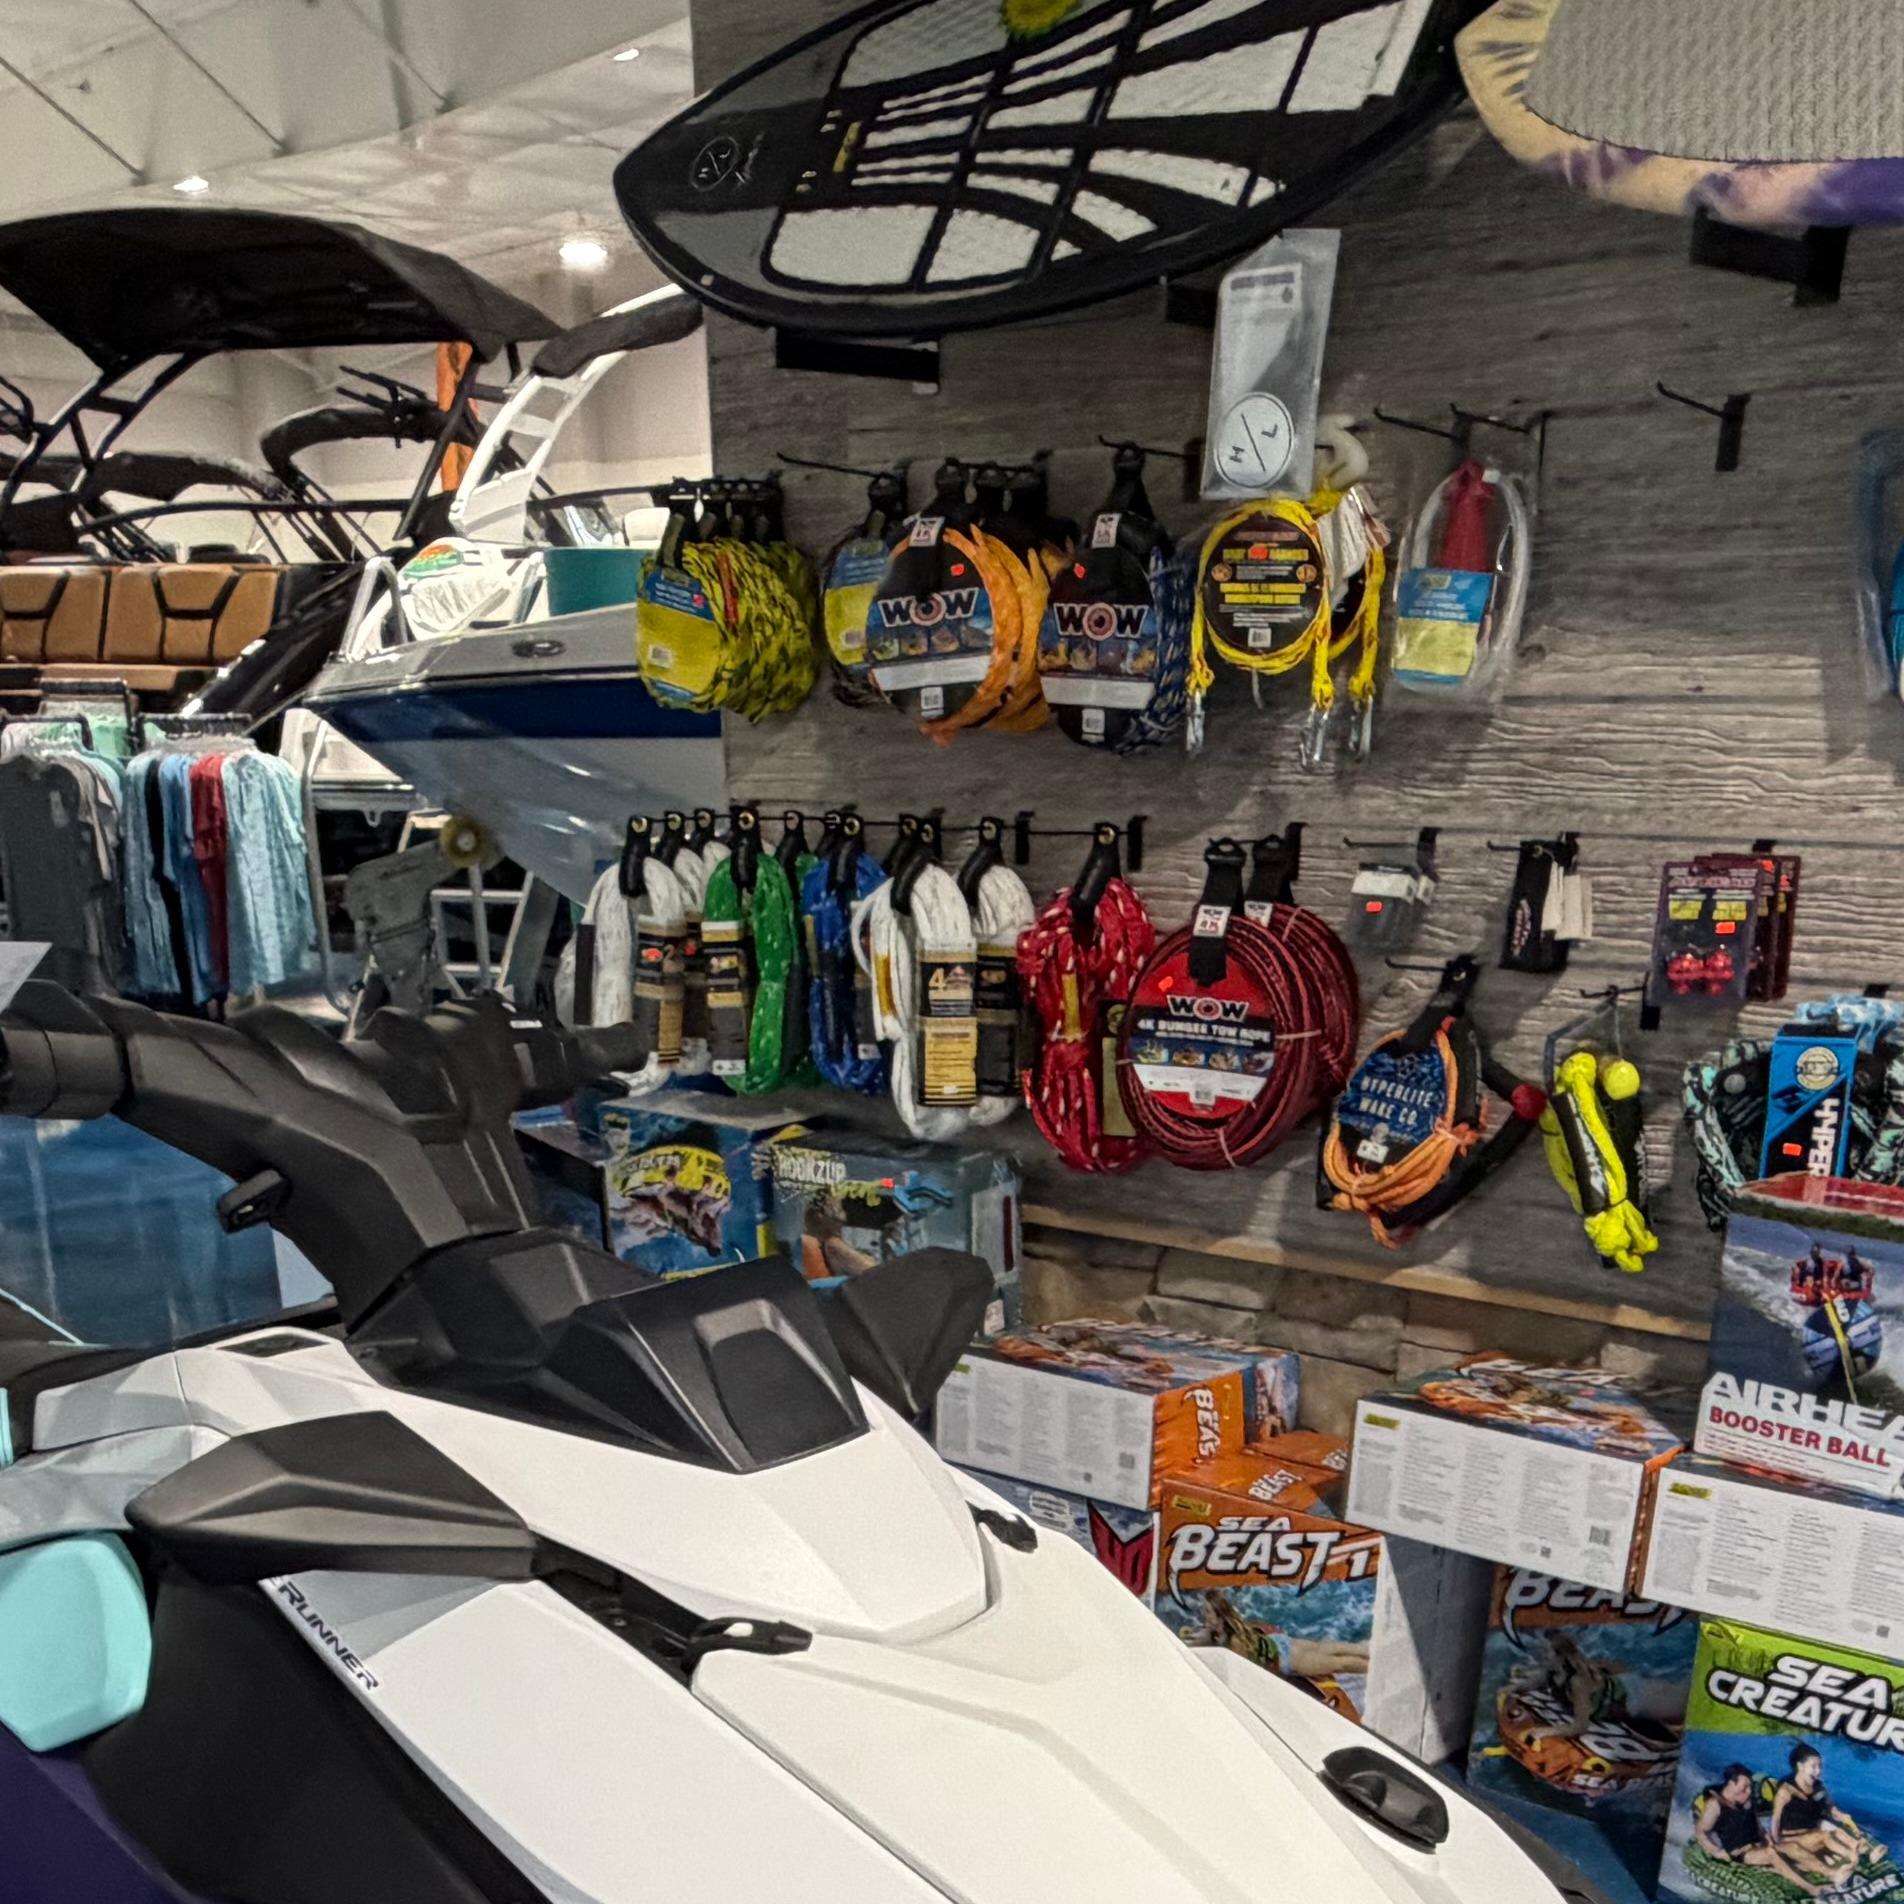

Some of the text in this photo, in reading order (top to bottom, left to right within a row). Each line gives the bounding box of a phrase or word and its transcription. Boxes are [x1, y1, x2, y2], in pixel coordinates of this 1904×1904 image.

[878, 586, 980, 628] WOW
[1053, 601, 1149, 642] WOW
[1166, 994, 1250, 1022] WOW
[1709, 1406, 1821, 1450] BOOSTER
[1827, 1436, 1891, 1467] BALL
[1216, 1516, 1291, 1531] SEA
[1166, 1523, 1342, 1610] BEAST
[1768, 1655, 1892, 1710] SEA
